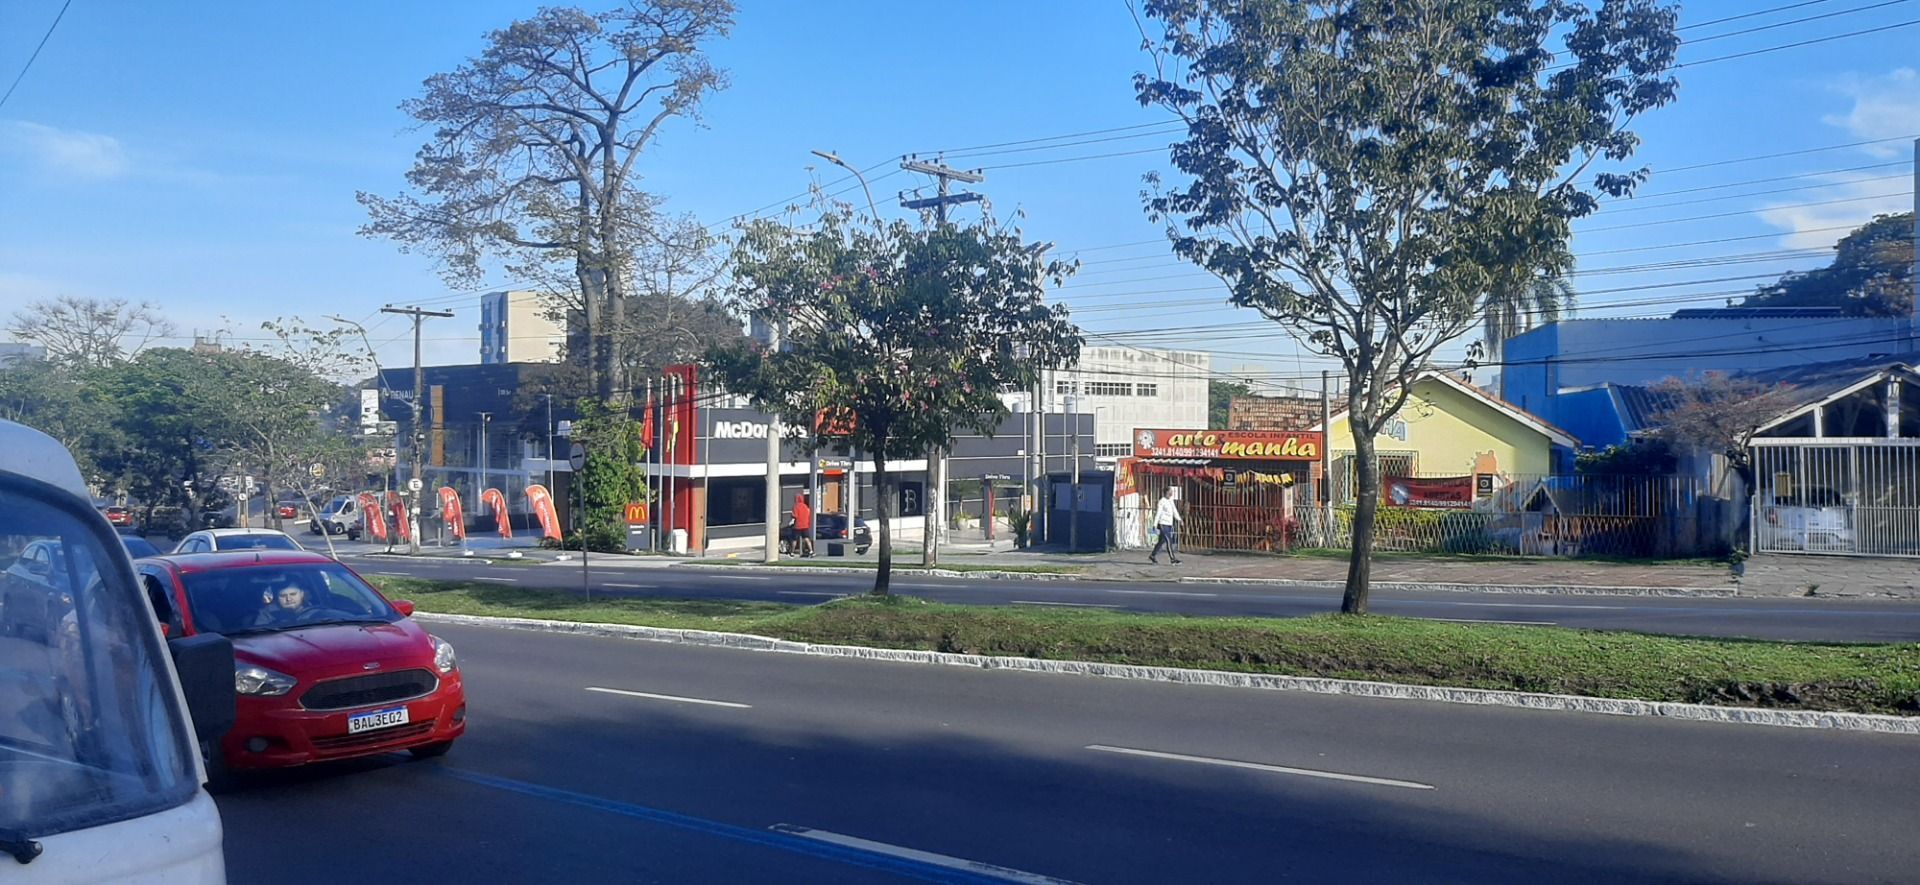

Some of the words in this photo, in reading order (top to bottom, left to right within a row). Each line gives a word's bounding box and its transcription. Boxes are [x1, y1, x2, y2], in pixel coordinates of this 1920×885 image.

[1168, 430, 1216, 446] arte
[1220, 437, 1316, 457] manha
[353, 711, 402, 730] BAL3E02
